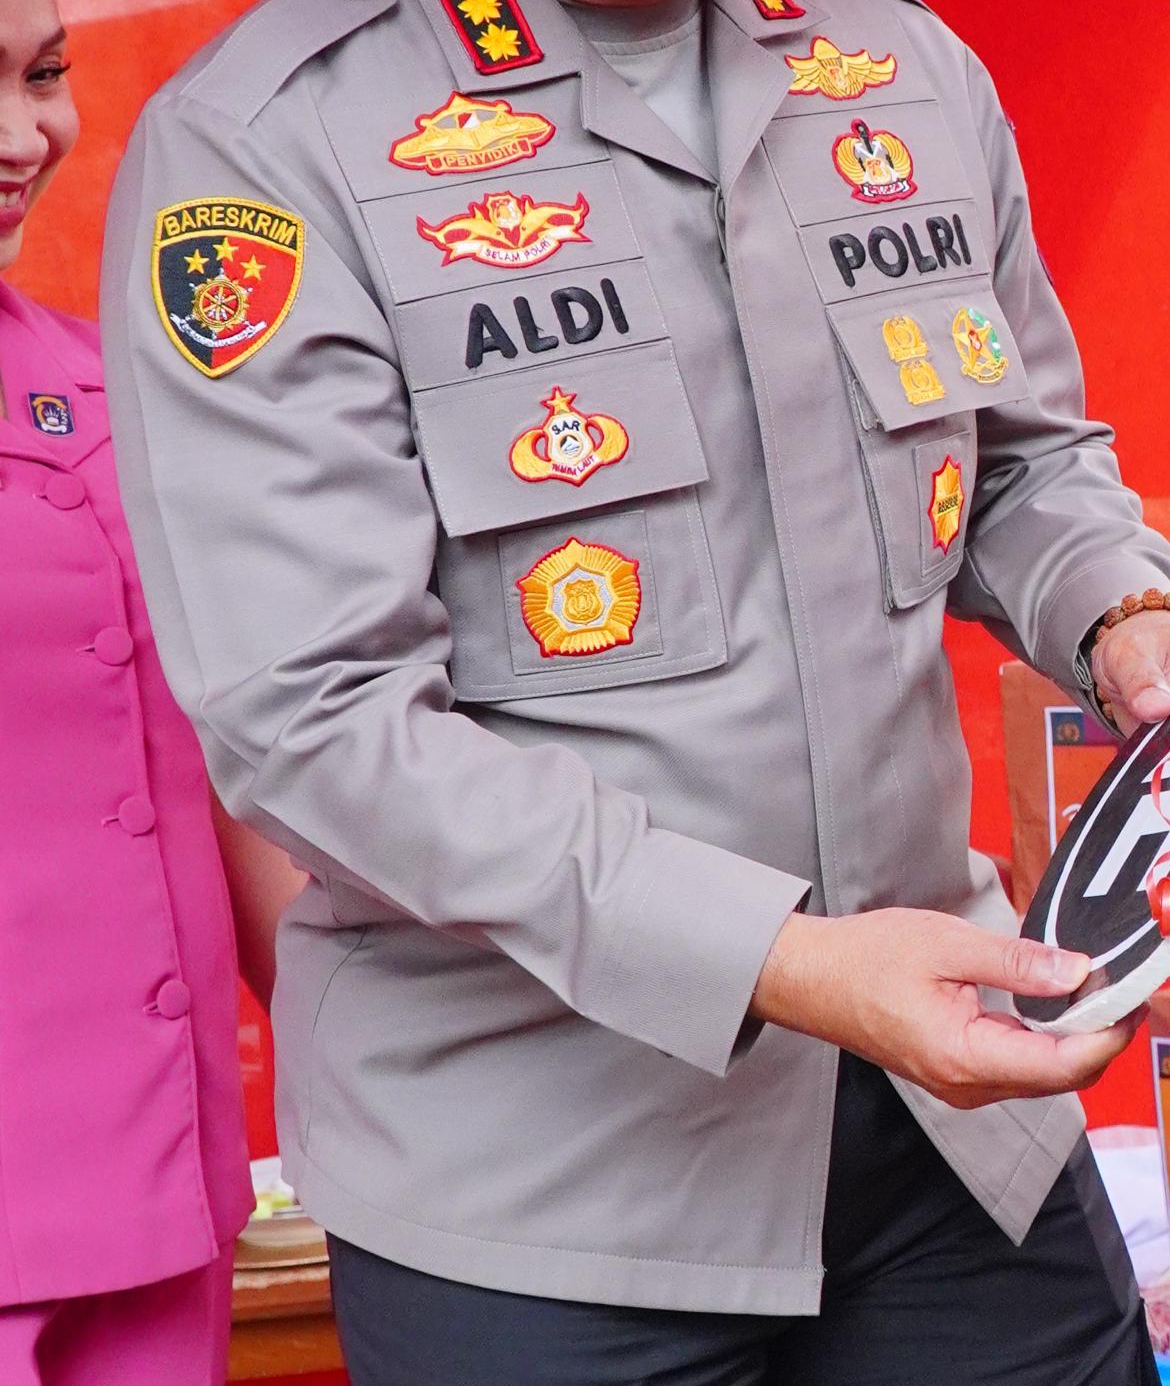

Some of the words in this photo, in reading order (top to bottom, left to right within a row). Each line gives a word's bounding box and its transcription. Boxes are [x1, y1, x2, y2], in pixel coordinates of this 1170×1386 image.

[446, 145, 519, 167] PENYIDIK
[163, 206, 297, 245] BARESKRIM
[485, 248, 520, 263] SELAM
[524, 238, 551, 259] POLRI
[829, 213, 972, 288] POLRI
[465, 278, 629, 370] ALDI
[551, 420, 581, 436] SAR
